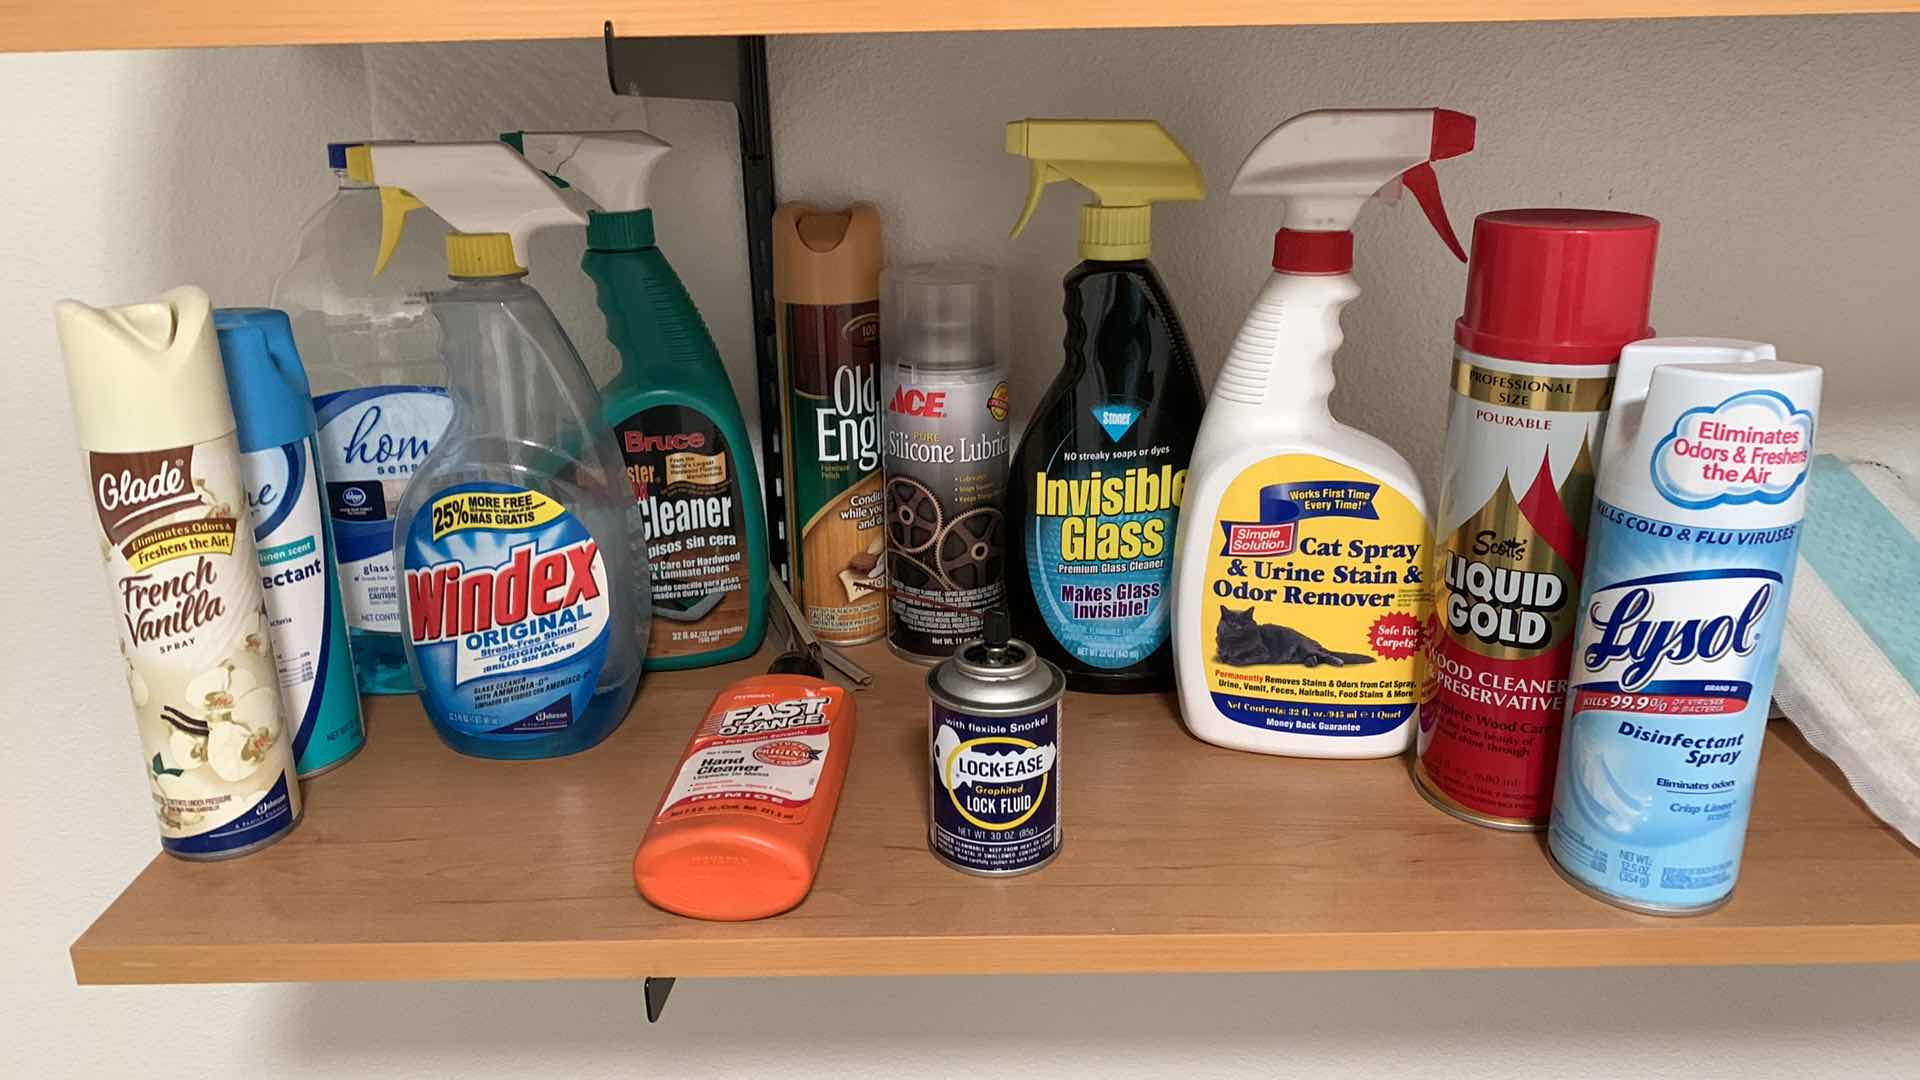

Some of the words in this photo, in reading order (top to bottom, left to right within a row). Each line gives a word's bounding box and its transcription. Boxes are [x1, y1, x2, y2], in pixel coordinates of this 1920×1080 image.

[834, 362, 875, 416] Old
[1469, 371, 1574, 394] PROFESSIONAL
[888, 383, 946, 419] ACE
[1498, 392, 1529, 406] SIZE
[1102, 410, 1132, 426] Stoner
[1476, 409, 1552, 431] POURABLE
[344, 406, 429, 464] hom
[624, 430, 705, 453] Bruce
[816, 400, 882, 471] Engl
[912, 432, 941, 444] PURE
[1698, 421, 1800, 444] Eliminates
[889, 430, 954, 463] Silicone
[959, 431, 1008, 464] Lubric
[1064, 452, 1077, 461] NO
[1079, 450, 1110, 464] streaky
[1112, 449, 1136, 462] soaps
[1139, 448, 1148, 456] or
[1151, 445, 1170, 458] dyes
[1674, 438, 1728, 462] Odors
[1732, 446, 1746, 464] &
[1751, 448, 1808, 466] Freshens
[377, 463, 418, 476] sens
[1702, 464, 1738, 482] the
[1741, 466, 1772, 484] Air
[98, 459, 185, 511] Glade
[1035, 464, 1188, 517] Invisible
[1289, 490, 1320, 501] Works
[1322, 488, 1346, 499] First
[1348, 490, 1371, 499] Time
[850, 491, 881, 506] Condit
[1304, 500, 1332, 512] Every
[433, 500, 469, 532] 25%
[468, 496, 500, 508] MORE
[503, 494, 533, 508] FREE
[495, 510, 535, 525] GRATIS
[638, 496, 732, 541] Cleaner
[840, 508, 867, 524] while
[132, 526, 190, 552] Eliminates
[192, 522, 224, 535] Odors
[1060, 516, 1165, 562] Glass
[1236, 528, 1281, 544] Simple
[1626, 517, 1673, 538] COLD
[1676, 528, 1690, 542] &
[1696, 531, 1732, 546] FLU
[1738, 526, 1796, 546] VIRUSES
[138, 542, 188, 565] Freshens
[190, 539, 208, 551] the
[210, 535, 230, 550] Air!
[288, 542, 312, 558] scent
[648, 540, 682, 559] pisos
[686, 536, 705, 550] sin
[709, 534, 737, 546] cera
[1232, 538, 1286, 552] Solution
[1299, 537, 1342, 556] Cat
[1348, 540, 1421, 564] Spray
[1472, 530, 1528, 561] Scott's
[362, 563, 390, 576] glass
[660, 560, 682, 572] Care
[682, 558, 696, 568] for
[696, 552, 740, 567] Hardwood
[661, 566, 702, 580] Laminate
[703, 564, 730, 575] Floors
[1058, 564, 1098, 574] Premium
[1101, 563, 1127, 573] Glass
[1129, 560, 1164, 571] Cleaner
[1227, 559, 1247, 578] &
[1254, 561, 1326, 583] Urine
[1333, 563, 1398, 585] Stain
[1402, 564, 1424, 585] &
[119, 555, 218, 614] French
[262, 560, 322, 590] ectant
[1446, 552, 1566, 609] LIQUID
[368, 592, 396, 600] CAUTION
[406, 542, 602, 642] Windex
[654, 591, 682, 601] madera
[682, 589, 700, 599] dura
[1062, 585, 1112, 602] Makes
[1116, 583, 1160, 600] Glass
[1212, 579, 1278, 603] Odor
[1283, 585, 1396, 608] Remover
[124, 588, 226, 649] Vanilla
[1074, 599, 1148, 619] Invisible!
[1448, 592, 1549, 645] GOLD
[465, 604, 593, 650] ORIGINAL
[672, 632, 682, 642] 32
[1378, 625, 1399, 636] Safe
[1402, 626, 1419, 637] For
[1585, 583, 1770, 686] Lysol
[160, 638, 197, 654] SPRAY
[480, 636, 542, 657] Streak-Free
[544, 624, 578, 644] Shine!
[1376, 637, 1418, 652] Carpets!
[498, 640, 559, 662] ORIGINAL
[522, 654, 540, 666] SIN
[474, 683, 496, 695] GLASS
[498, 676, 526, 692] CLEANER
[1214, 670, 1264, 681] Permanently
[1264, 676, 1301, 687] Removes
[1302, 678, 1327, 688] Stains
[1336, 681, 1359, 689] Odors
[1394, 682, 1418, 691] Spray,
[1218, 680, 1242, 691] Urine,
[1243, 683, 1268, 694] Vomit,
[1270, 686, 1298, 697] Feces,
[1298, 689, 1338, 699] Hairballs,
[1359, 691, 1384, 699] Stains
[1394, 691, 1414, 699] More
[1478, 672, 1568, 696] CLEANER
[474, 692, 492, 702] WITH
[1437, 675, 1563, 711] PRESERVATIVE
[722, 697, 831, 727] FAST
[1226, 701, 1242, 711] Net
[1244, 704, 1286, 716] Contents:
[1377, 712, 1402, 721] Quart
[1584, 697, 1608, 707] KILLS
[1608, 695, 1668, 712] 99.9%
[718, 714, 827, 736] ORANGE
[945, 718, 966, 730] with
[968, 724, 1006, 734] flexible
[1010, 714, 1049, 734] Snorkel
[1266, 718, 1294, 730] Money
[1295, 720, 1317, 729] Back
[1318, 722, 1362, 733] Guarantee
[1474, 716, 1516, 732] Wood
[1484, 730, 1518, 746] beauty
[1618, 721, 1744, 750] Disinfectant
[1487, 741, 1530, 758] through
[1686, 750, 1742, 768] Spray
[696, 764, 764, 776] Cleaner
[700, 756, 745, 768] Hand
[975, 784, 1024, 799] Graphited
[1656, 778, 1710, 790] Eliminates
[1712, 780, 1736, 790] odors
[691, 792, 784, 804] PUMICE
[966, 795, 996, 814] LOCK
[1000, 794, 1032, 814] FLUID
[1670, 803, 1700, 815] Crisp
[958, 826, 972, 839] NET
[975, 830, 986, 841] WT
[1004, 832, 1015, 842] OZ
[1619, 849, 1636, 862] NET
